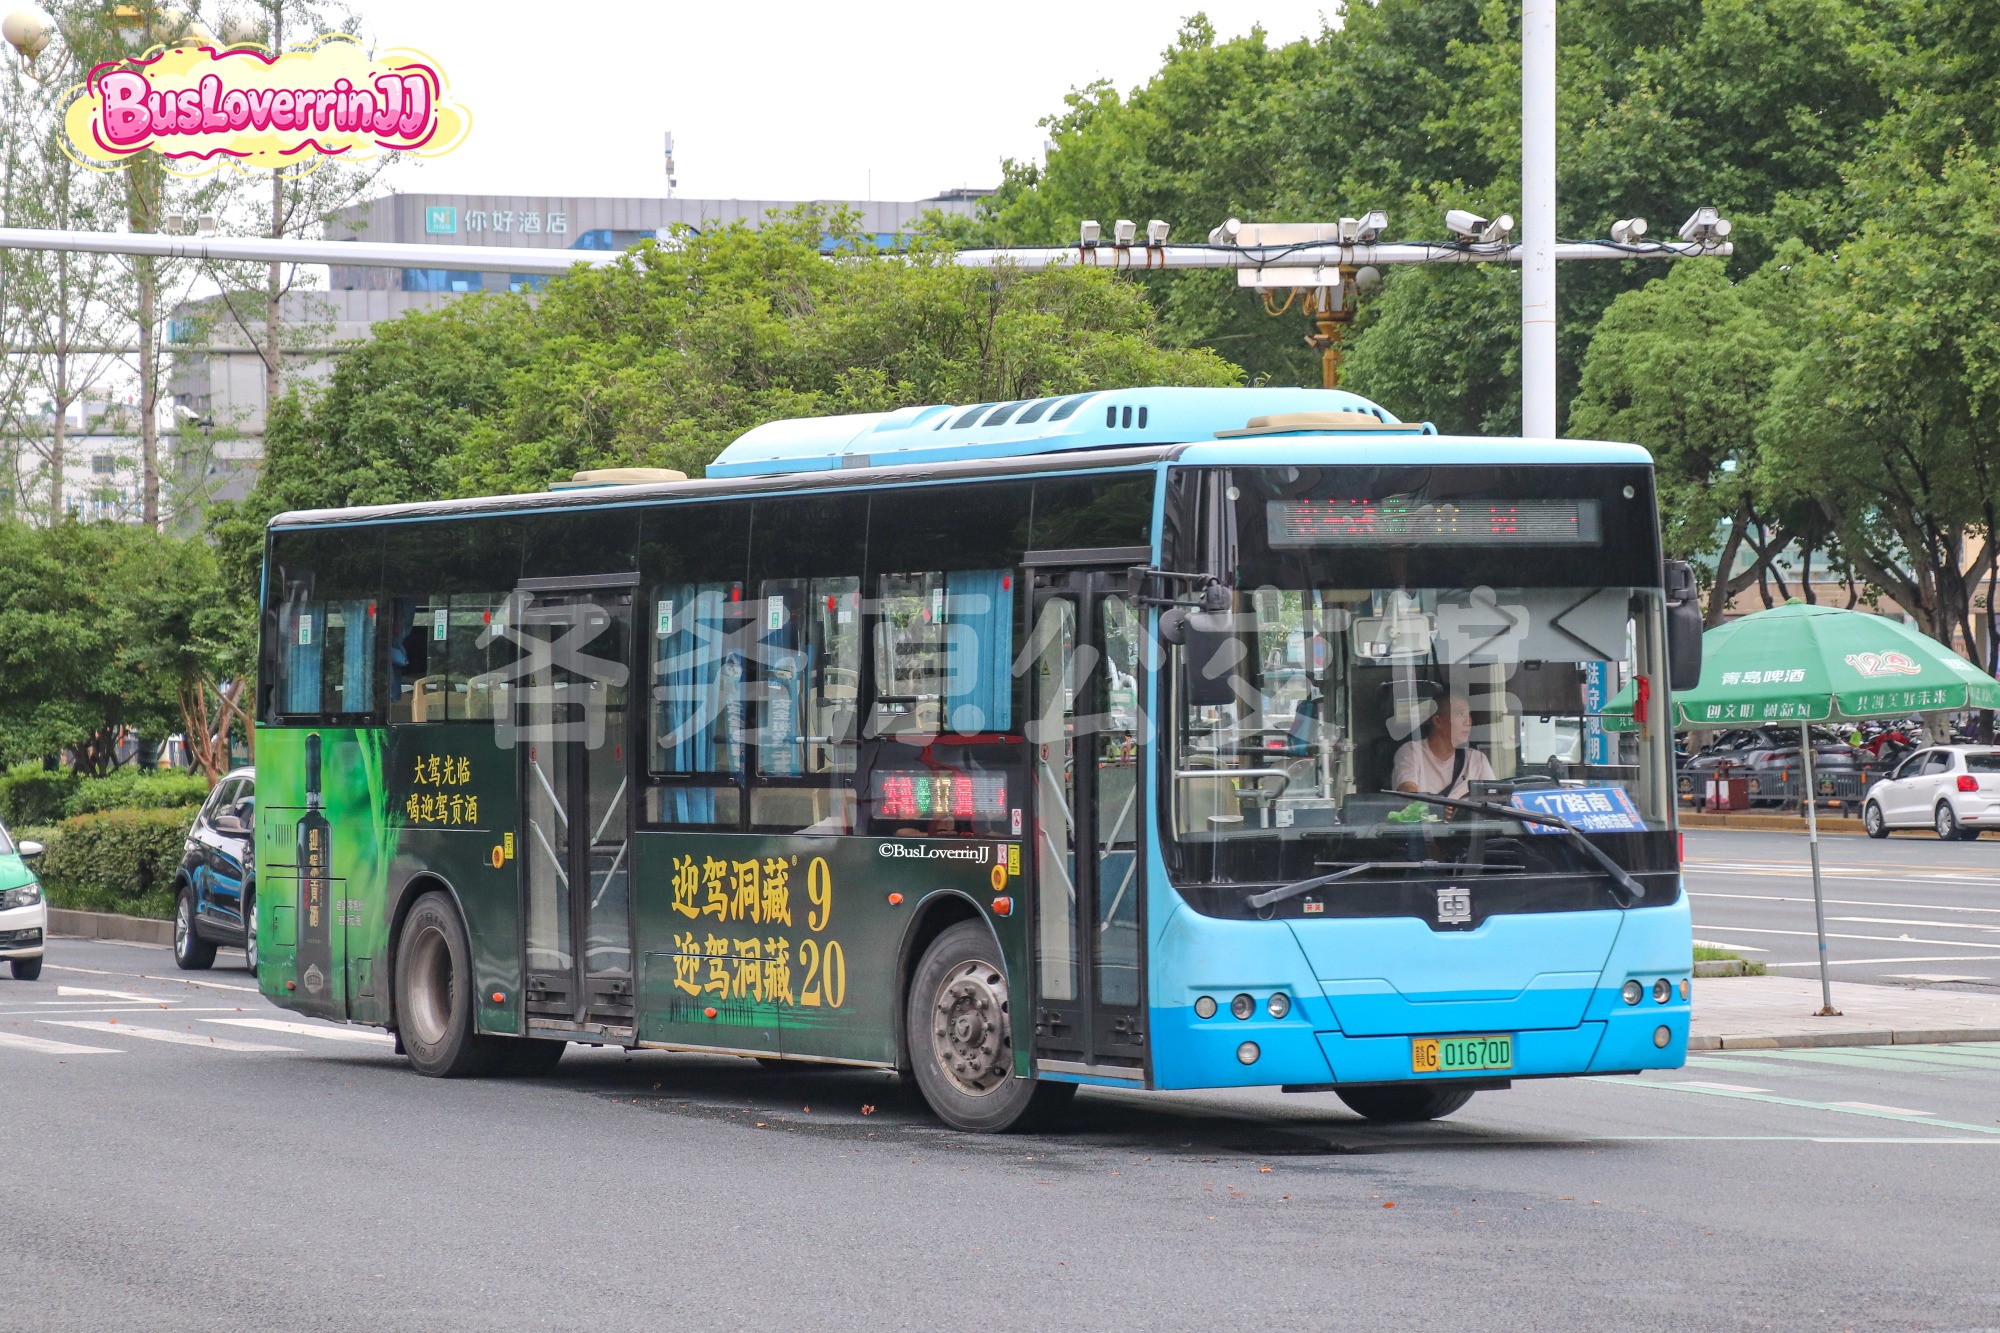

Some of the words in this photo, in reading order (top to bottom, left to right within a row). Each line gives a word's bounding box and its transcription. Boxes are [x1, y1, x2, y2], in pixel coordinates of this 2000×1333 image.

[464, 210, 567, 233] 你好酒店
[1721, 669, 1806, 685] 青岛啤酒
[1706, 704, 1754, 719] 创文明
[1763, 703, 1810, 718] 树新风
[1857, 690, 1946, 712] 共创美好未来
[413, 753, 471, 787] 大驾光临
[406, 791, 478, 825] 喝迎驾贡酒
[1534, 793, 1613, 814] 17路南
[807, 856, 832, 932] 9
[673, 931, 794, 1007] 迎驾洞藏
[799, 938, 846, 1008] 20
